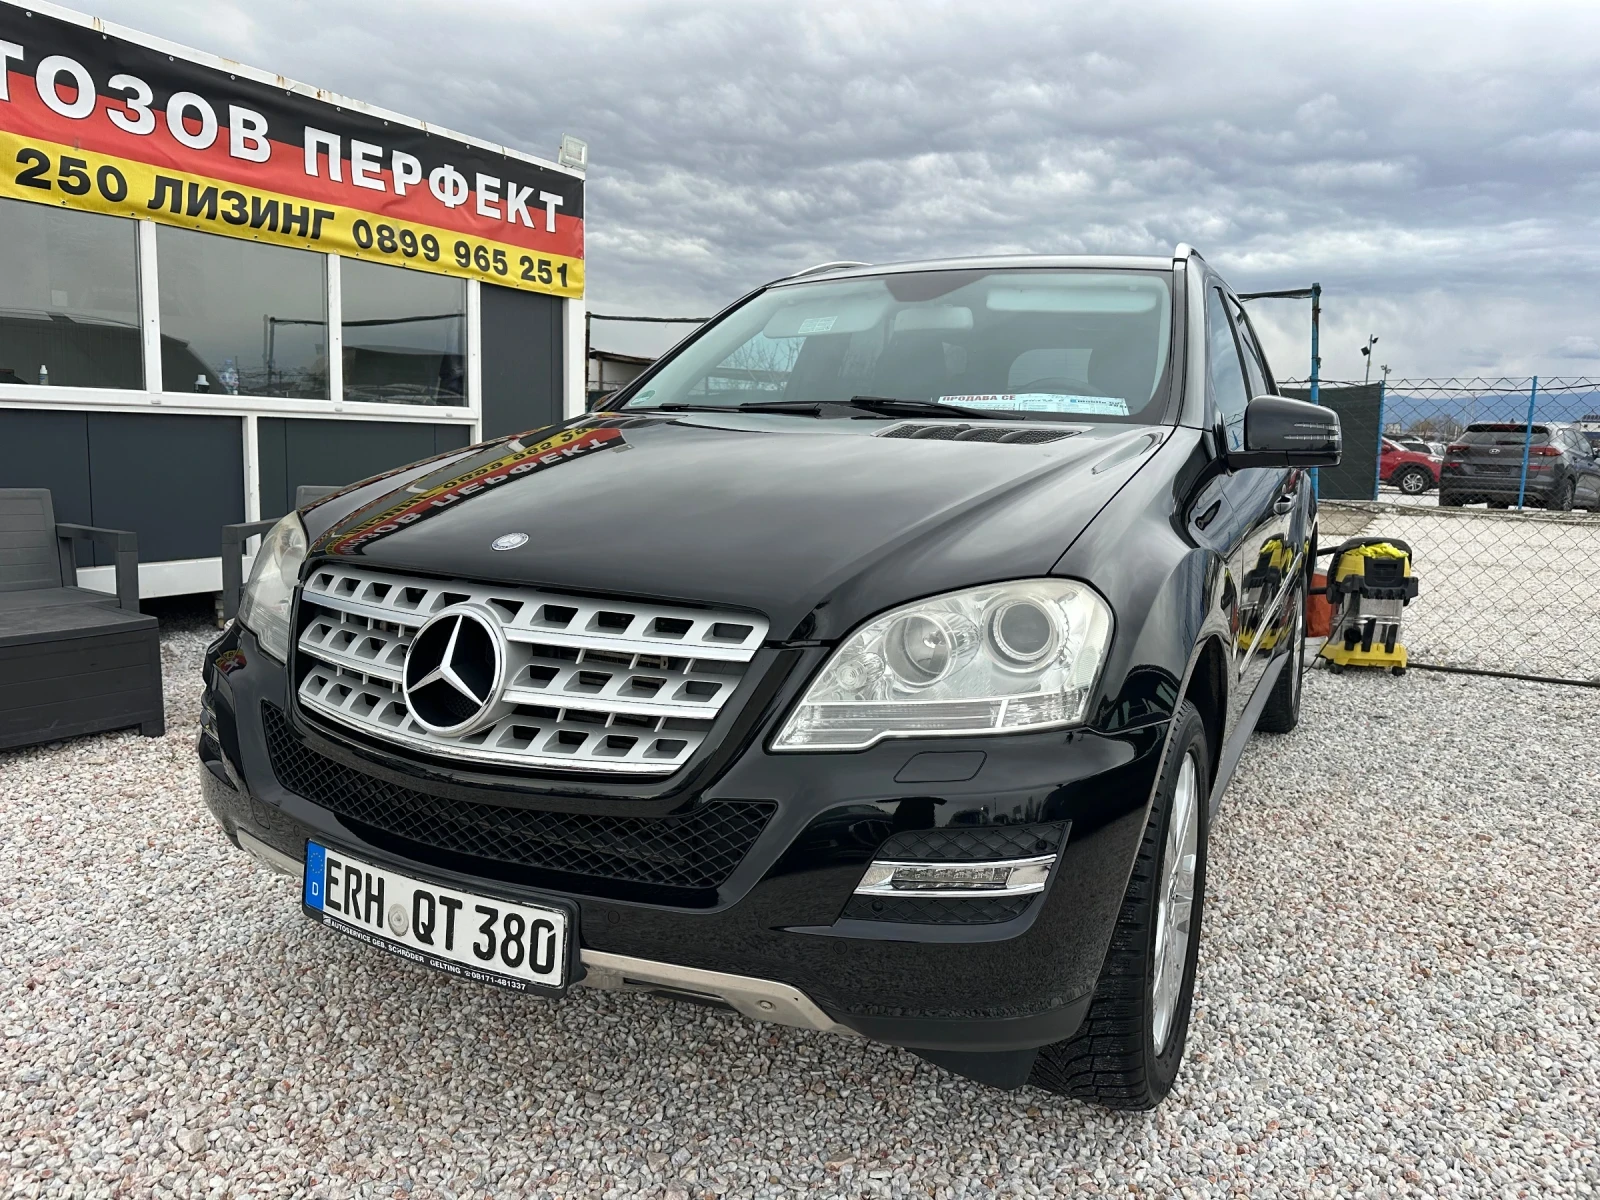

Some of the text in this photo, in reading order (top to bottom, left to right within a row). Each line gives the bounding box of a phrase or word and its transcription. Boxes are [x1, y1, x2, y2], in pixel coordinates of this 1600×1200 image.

[15, 147, 569, 289] 250 ЛИЗИНГ 0899 965 251
[303, 125, 564, 234] ПЕРФЕКТ
[311, 856, 556, 975] D ERH QT 380
[331, 920, 371, 943] AUTOSERVICE
[372, 938, 387, 950] GEB.
[429, 959, 461, 975] GELTING
[471, 971, 526, 991] 08171-481337
